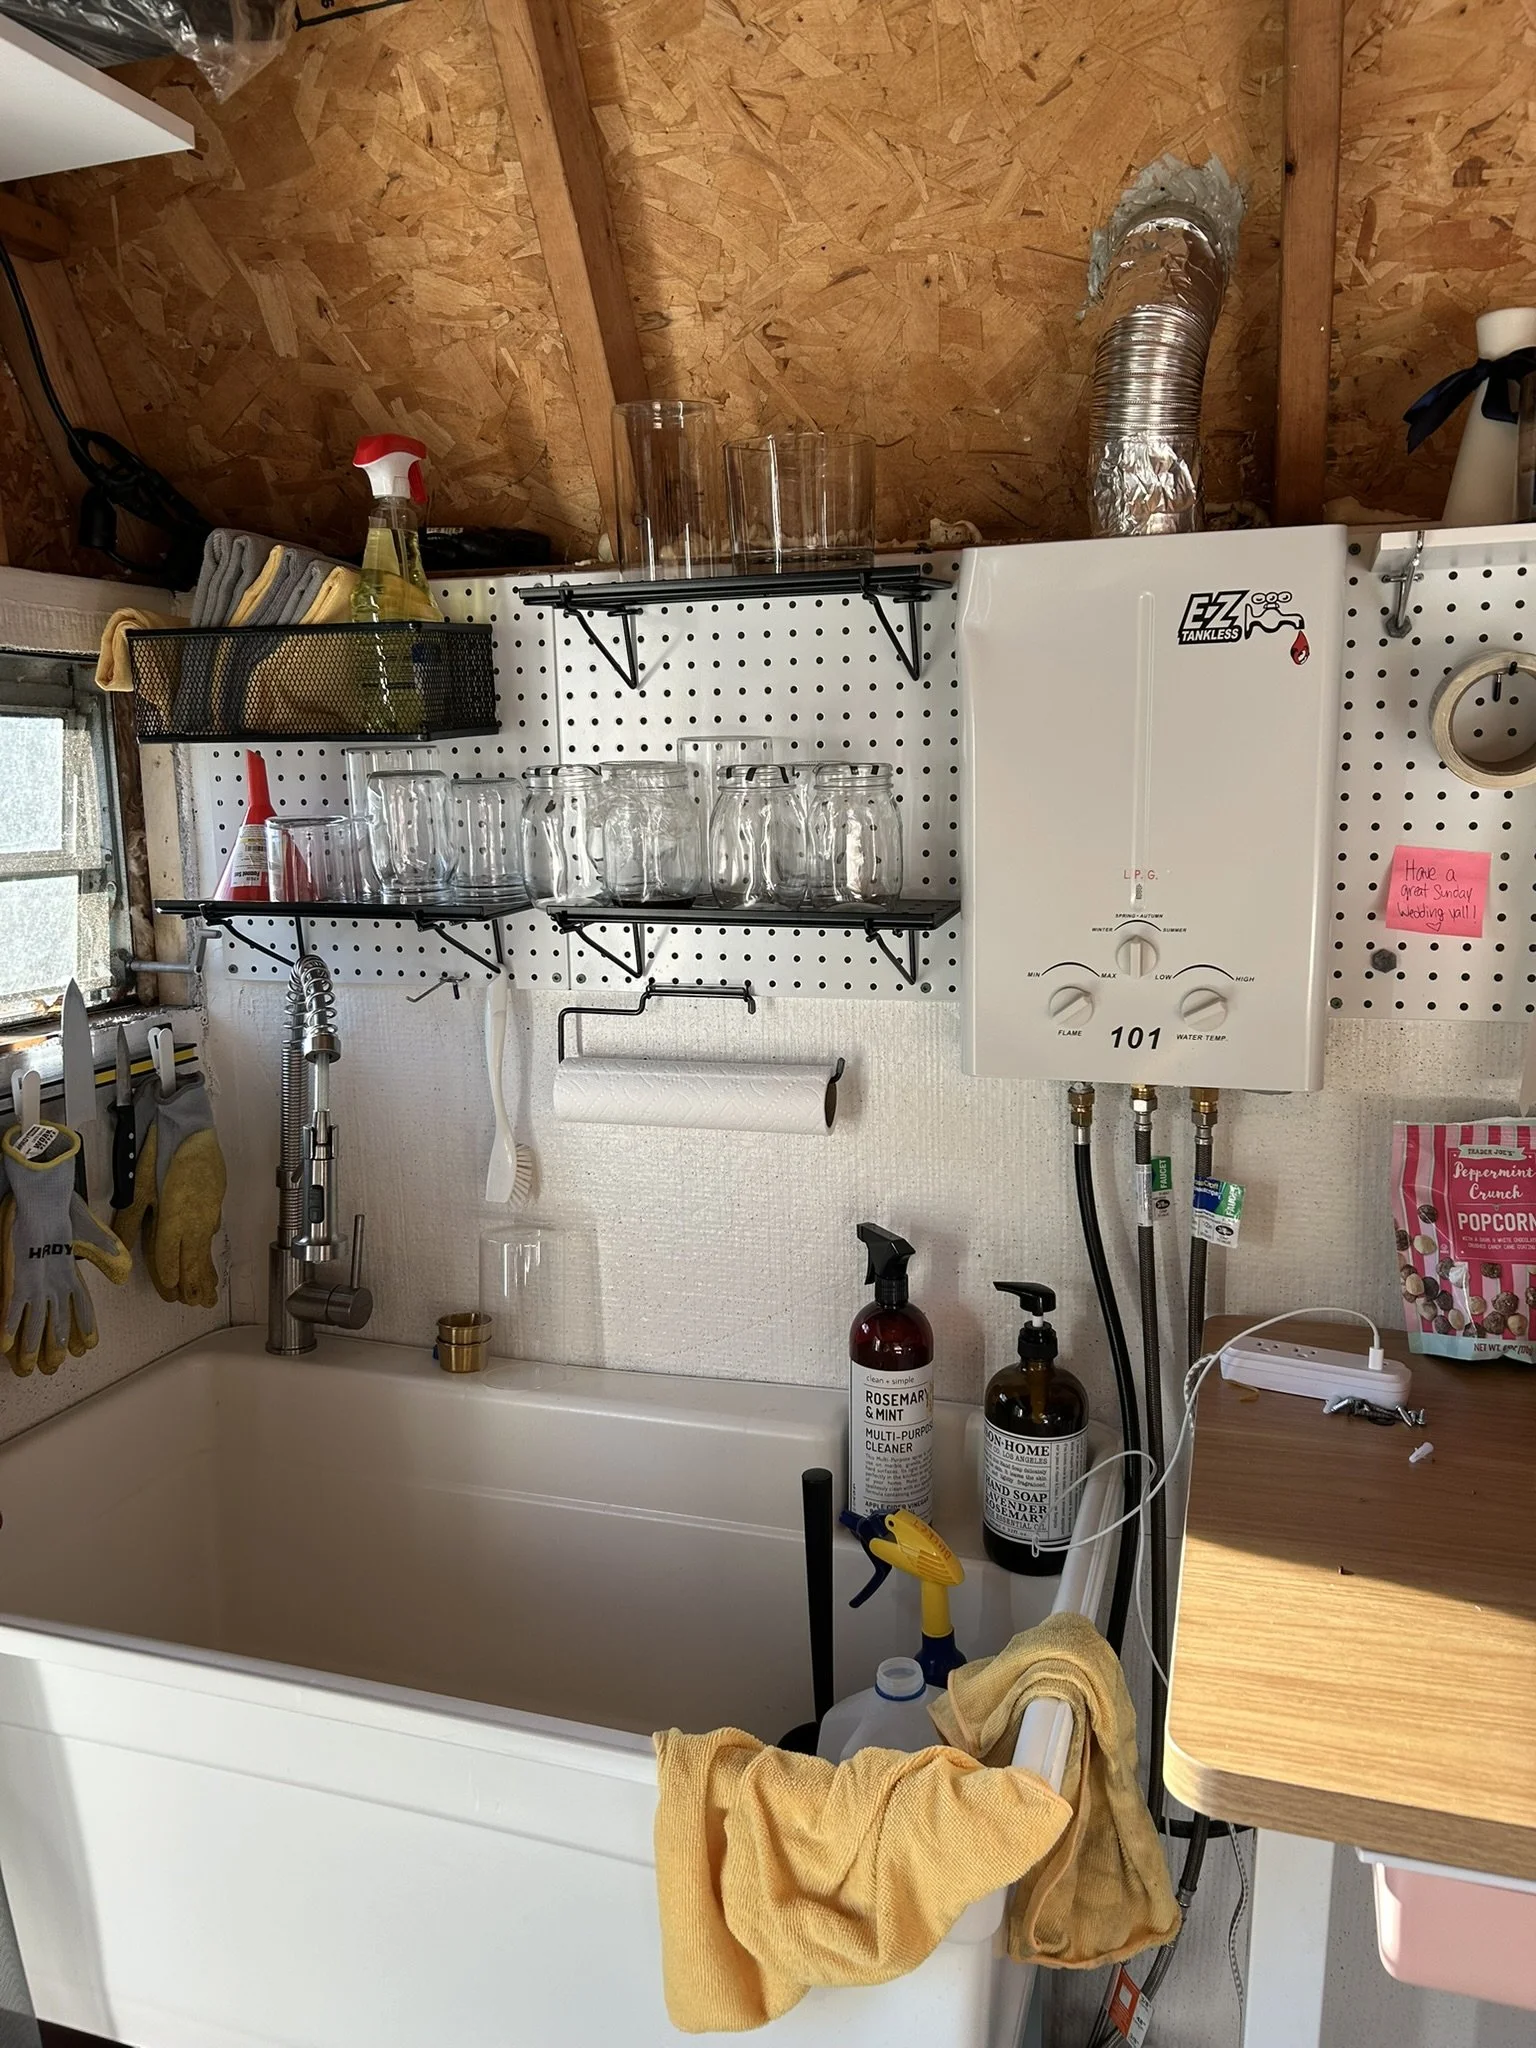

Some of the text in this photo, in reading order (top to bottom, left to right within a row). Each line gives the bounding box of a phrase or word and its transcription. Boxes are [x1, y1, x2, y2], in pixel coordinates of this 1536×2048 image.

[1180, 627, 1240, 642] TANKLESS
[1405, 859, 1457, 882] Have a
[1400, 878, 1473, 903] great Sunday
[1397, 902, 1444, 922] Wedding
[1235, 975, 1255, 983] HIGH
[1057, 1029, 1083, 1037] FLAME
[1110, 1025, 1161, 1050] 101
[1176, 1033, 1203, 1041] WATER
[1453, 1161, 1536, 1182] Peppermint
[1469, 1183, 1523, 1200] Crunch
[866, 1374, 884, 1383] clean
[892, 1376, 915, 1386] simple
[865, 1388, 929, 1408] ROSEMARY
[865, 1405, 904, 1421] & MINT
[865, 1440, 913, 1454] CLEANER
[1002, 1450, 1014, 1460] LOS
[1015, 1455, 1048, 1465] ANGELES
[985, 1474, 1048, 1503] HAND SOAP
[865, 1500, 884, 1509] APPLE
